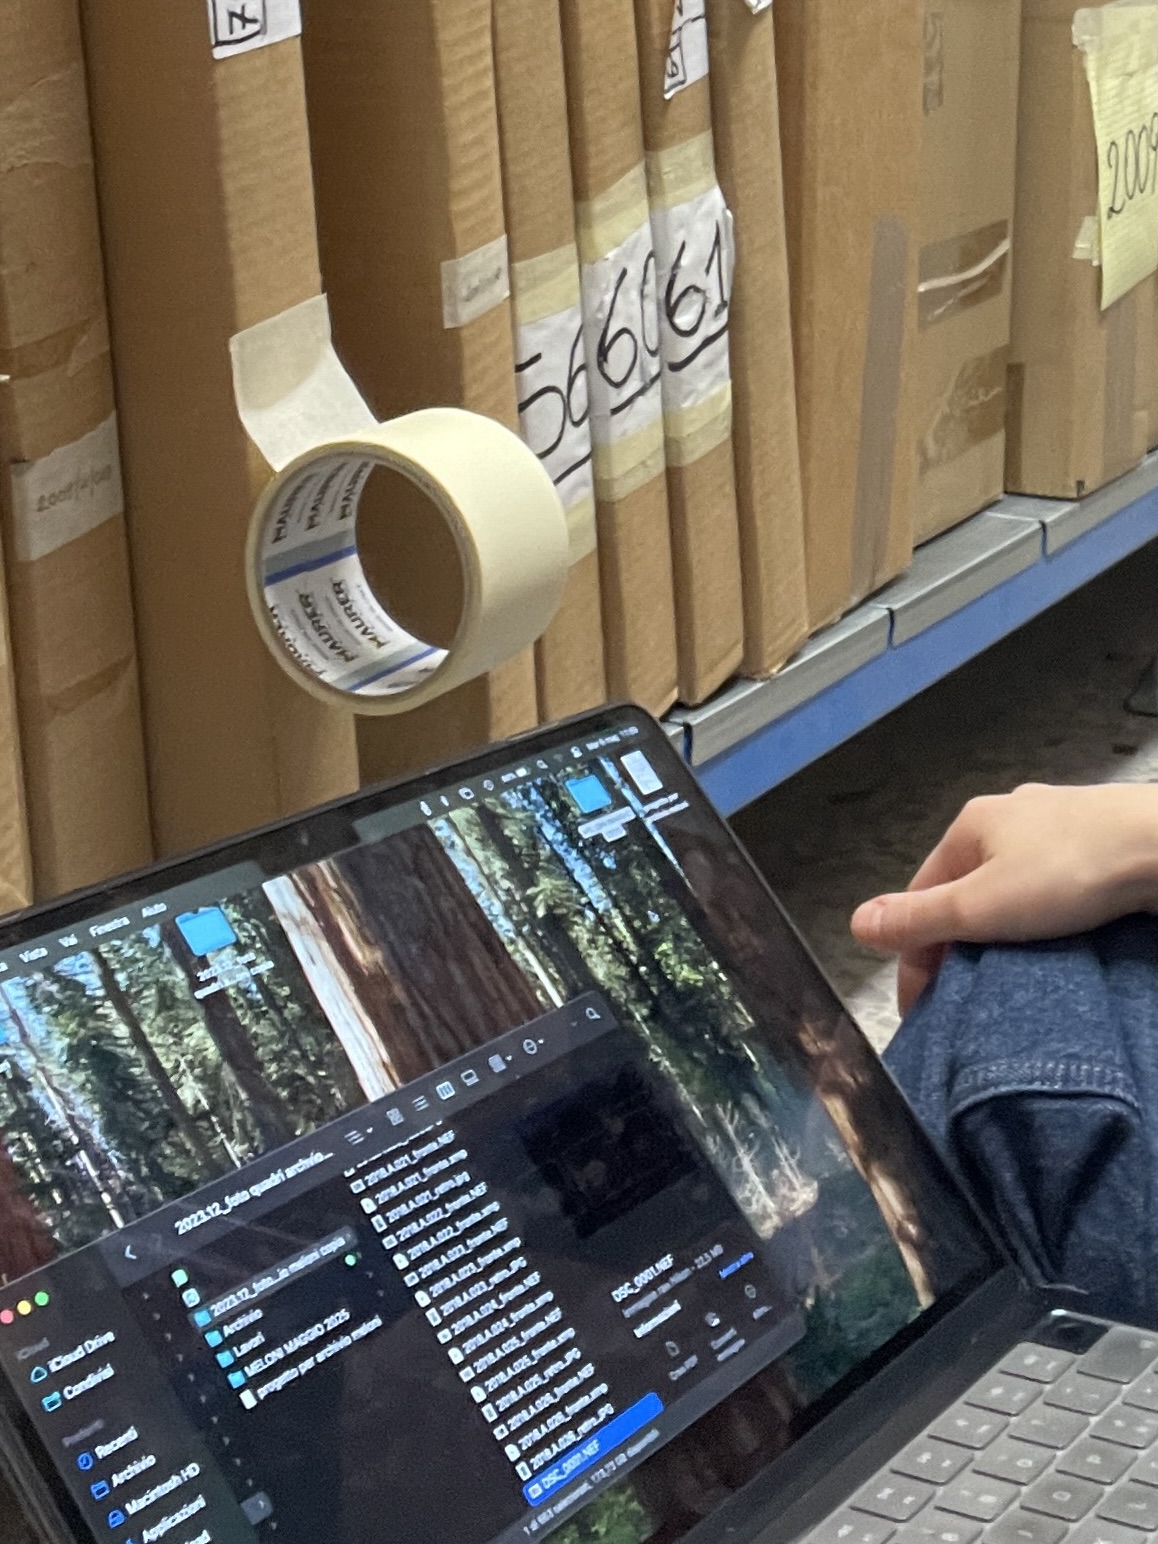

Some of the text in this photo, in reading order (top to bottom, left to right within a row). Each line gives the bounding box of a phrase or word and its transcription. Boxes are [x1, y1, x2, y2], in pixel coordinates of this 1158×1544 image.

[664, 219, 729, 338] 61
[514, 323, 590, 460] 56
[296, 591, 359, 663] MAURER
[330, 578, 391, 649] MAURER
[18, 944, 48, 964] Vista
[88, 913, 130, 937] Finestra
[47, 1328, 116, 1373] iCloud Drive
[282, 1322, 326, 1354] MAGGIO
[322, 1307, 351, 1330] 2025
[108, 1452, 157, 1488] Archivio
[124, 1461, 201, 1515] Macintosh HD
